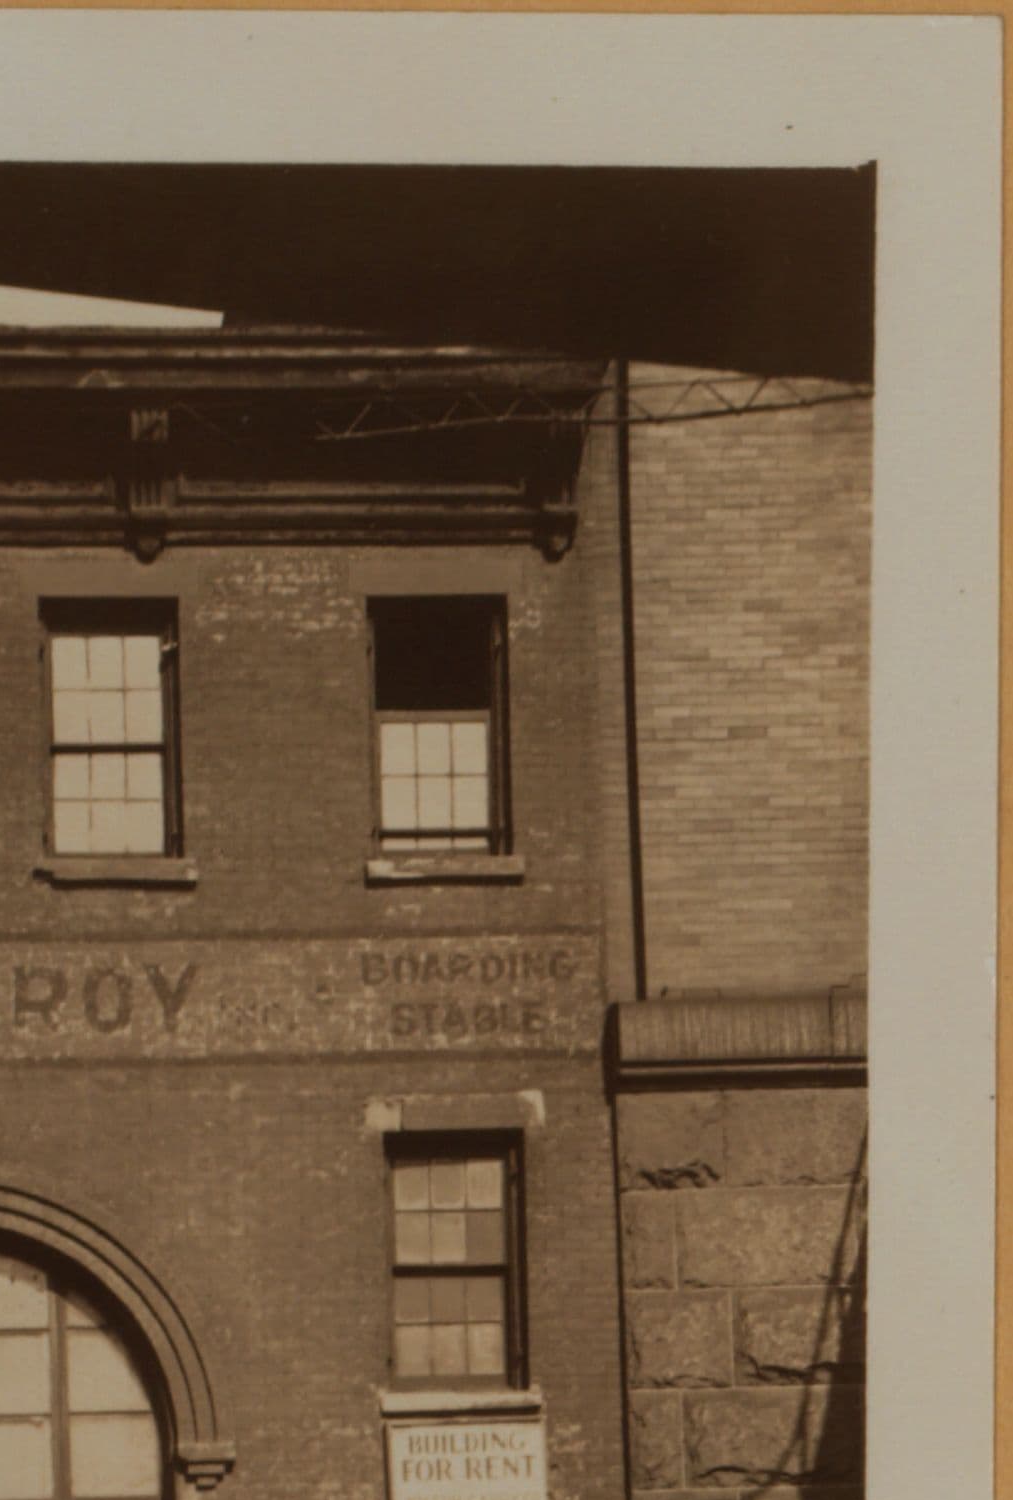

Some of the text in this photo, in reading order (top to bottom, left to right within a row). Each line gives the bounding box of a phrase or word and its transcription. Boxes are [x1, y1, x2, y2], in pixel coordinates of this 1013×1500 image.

[360, 951, 579, 986] BOARDING
[390, 1001, 550, 1036] STABLE
[407, 1432, 526, 1455] BUILDING
[401, 1454, 537, 1482] FOR RENT
